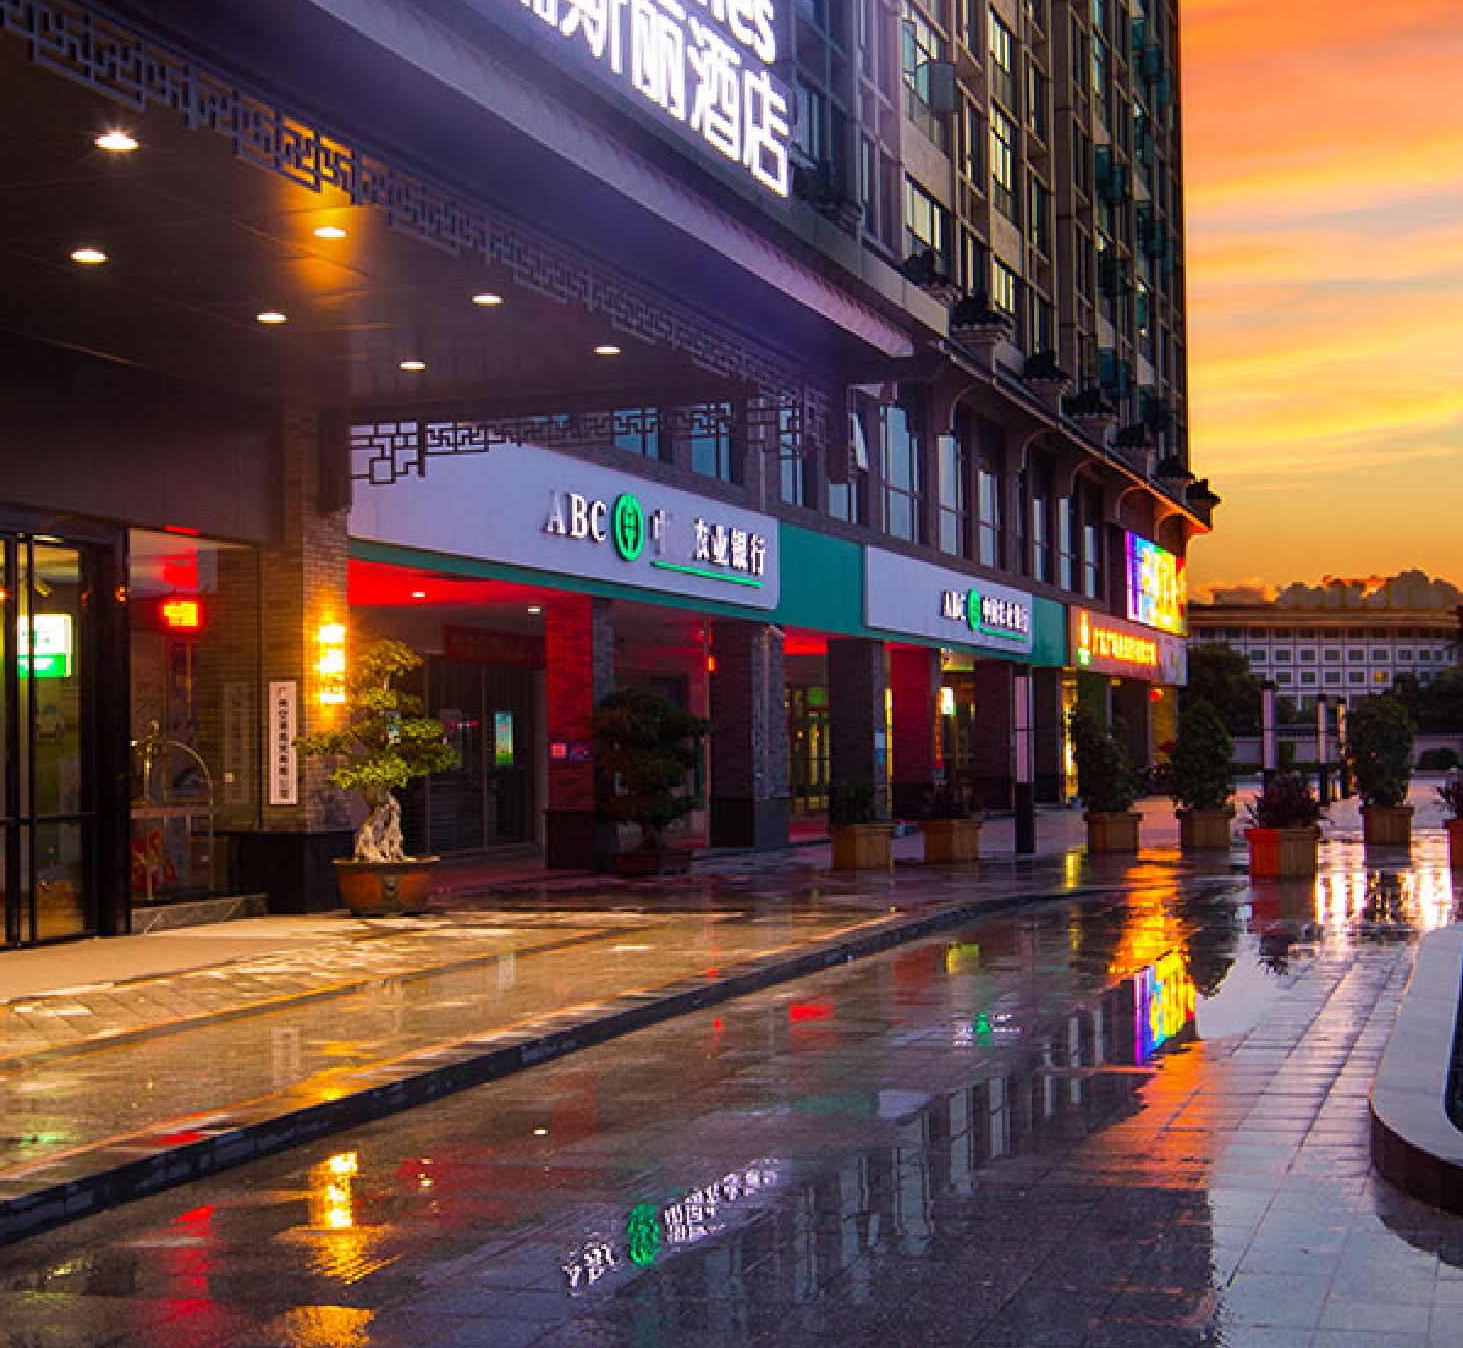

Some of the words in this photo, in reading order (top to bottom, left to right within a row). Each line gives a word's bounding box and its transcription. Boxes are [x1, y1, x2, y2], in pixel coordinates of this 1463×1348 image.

[544, 490, 607, 543] ABC
[648, 508, 765, 577] 农业银行
